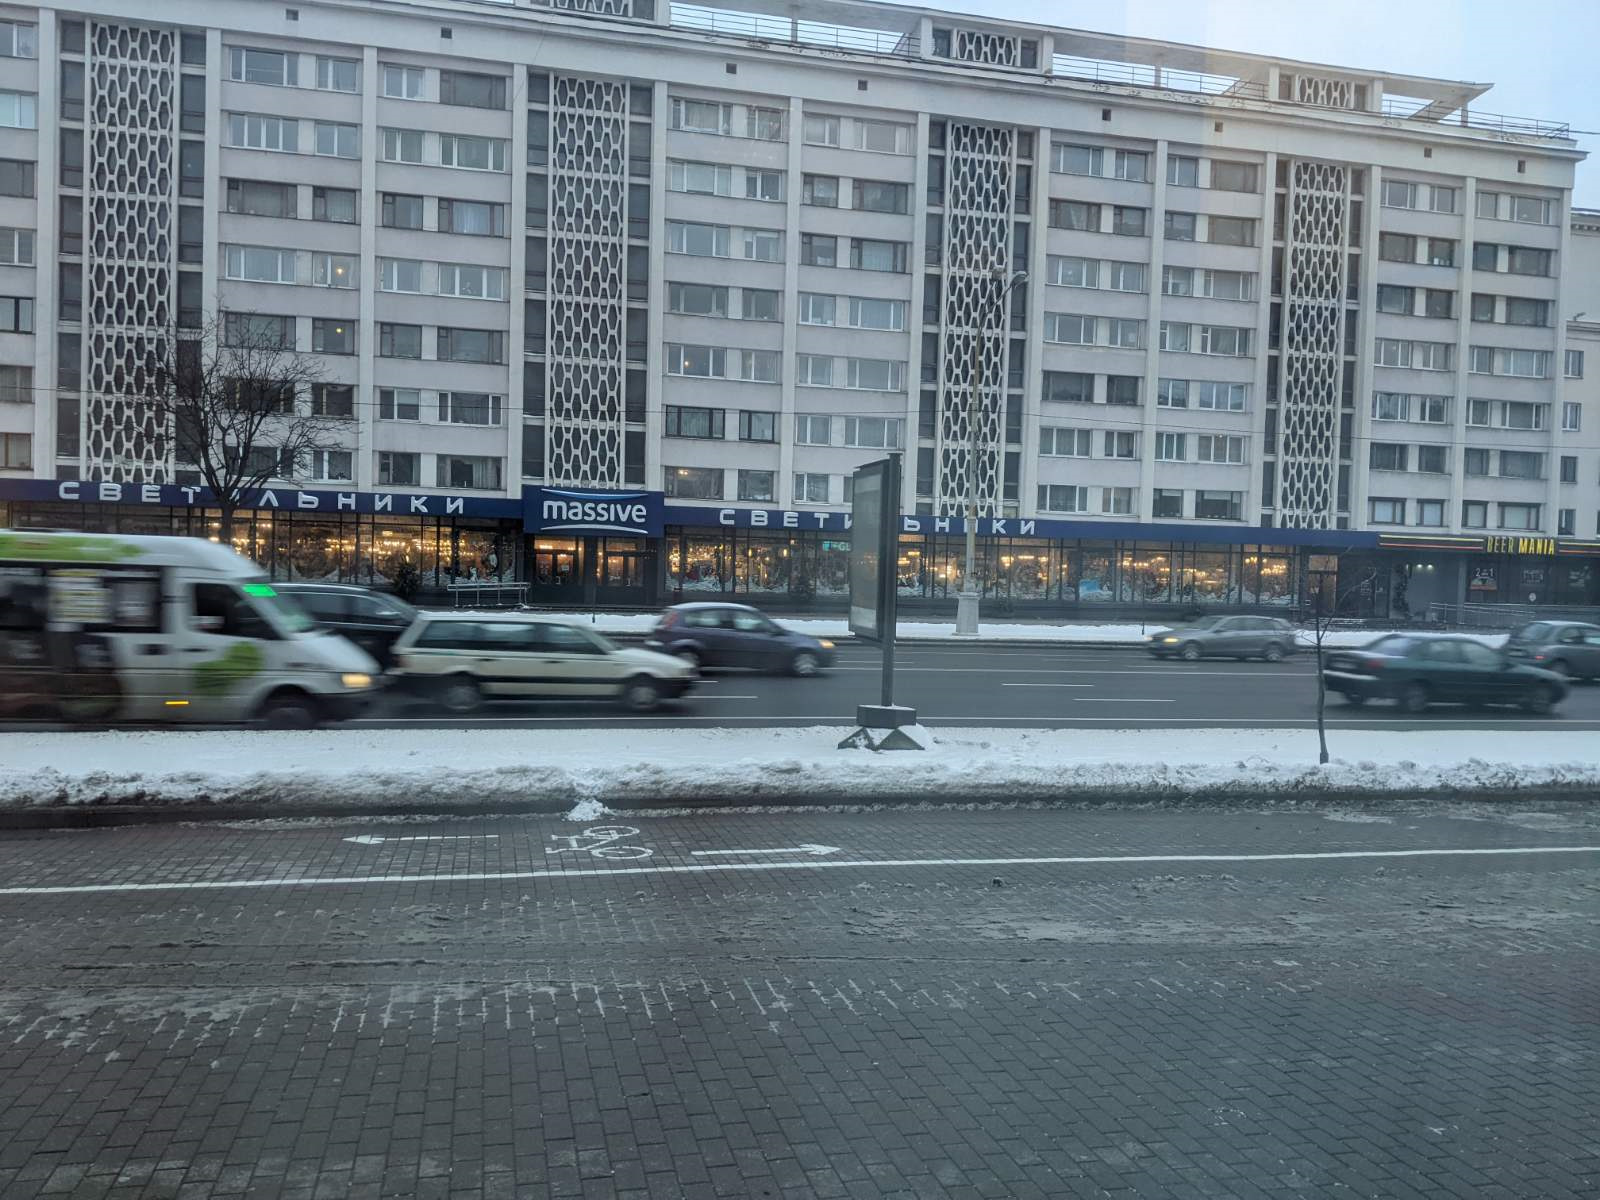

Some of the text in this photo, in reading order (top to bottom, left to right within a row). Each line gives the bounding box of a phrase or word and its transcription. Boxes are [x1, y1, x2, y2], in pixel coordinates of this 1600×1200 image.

[542, 500, 647, 522] massive
[720, 509, 1035, 535] СВЕТИЬНКИ
[1487, 536, 1555, 555] BEER MANIA
